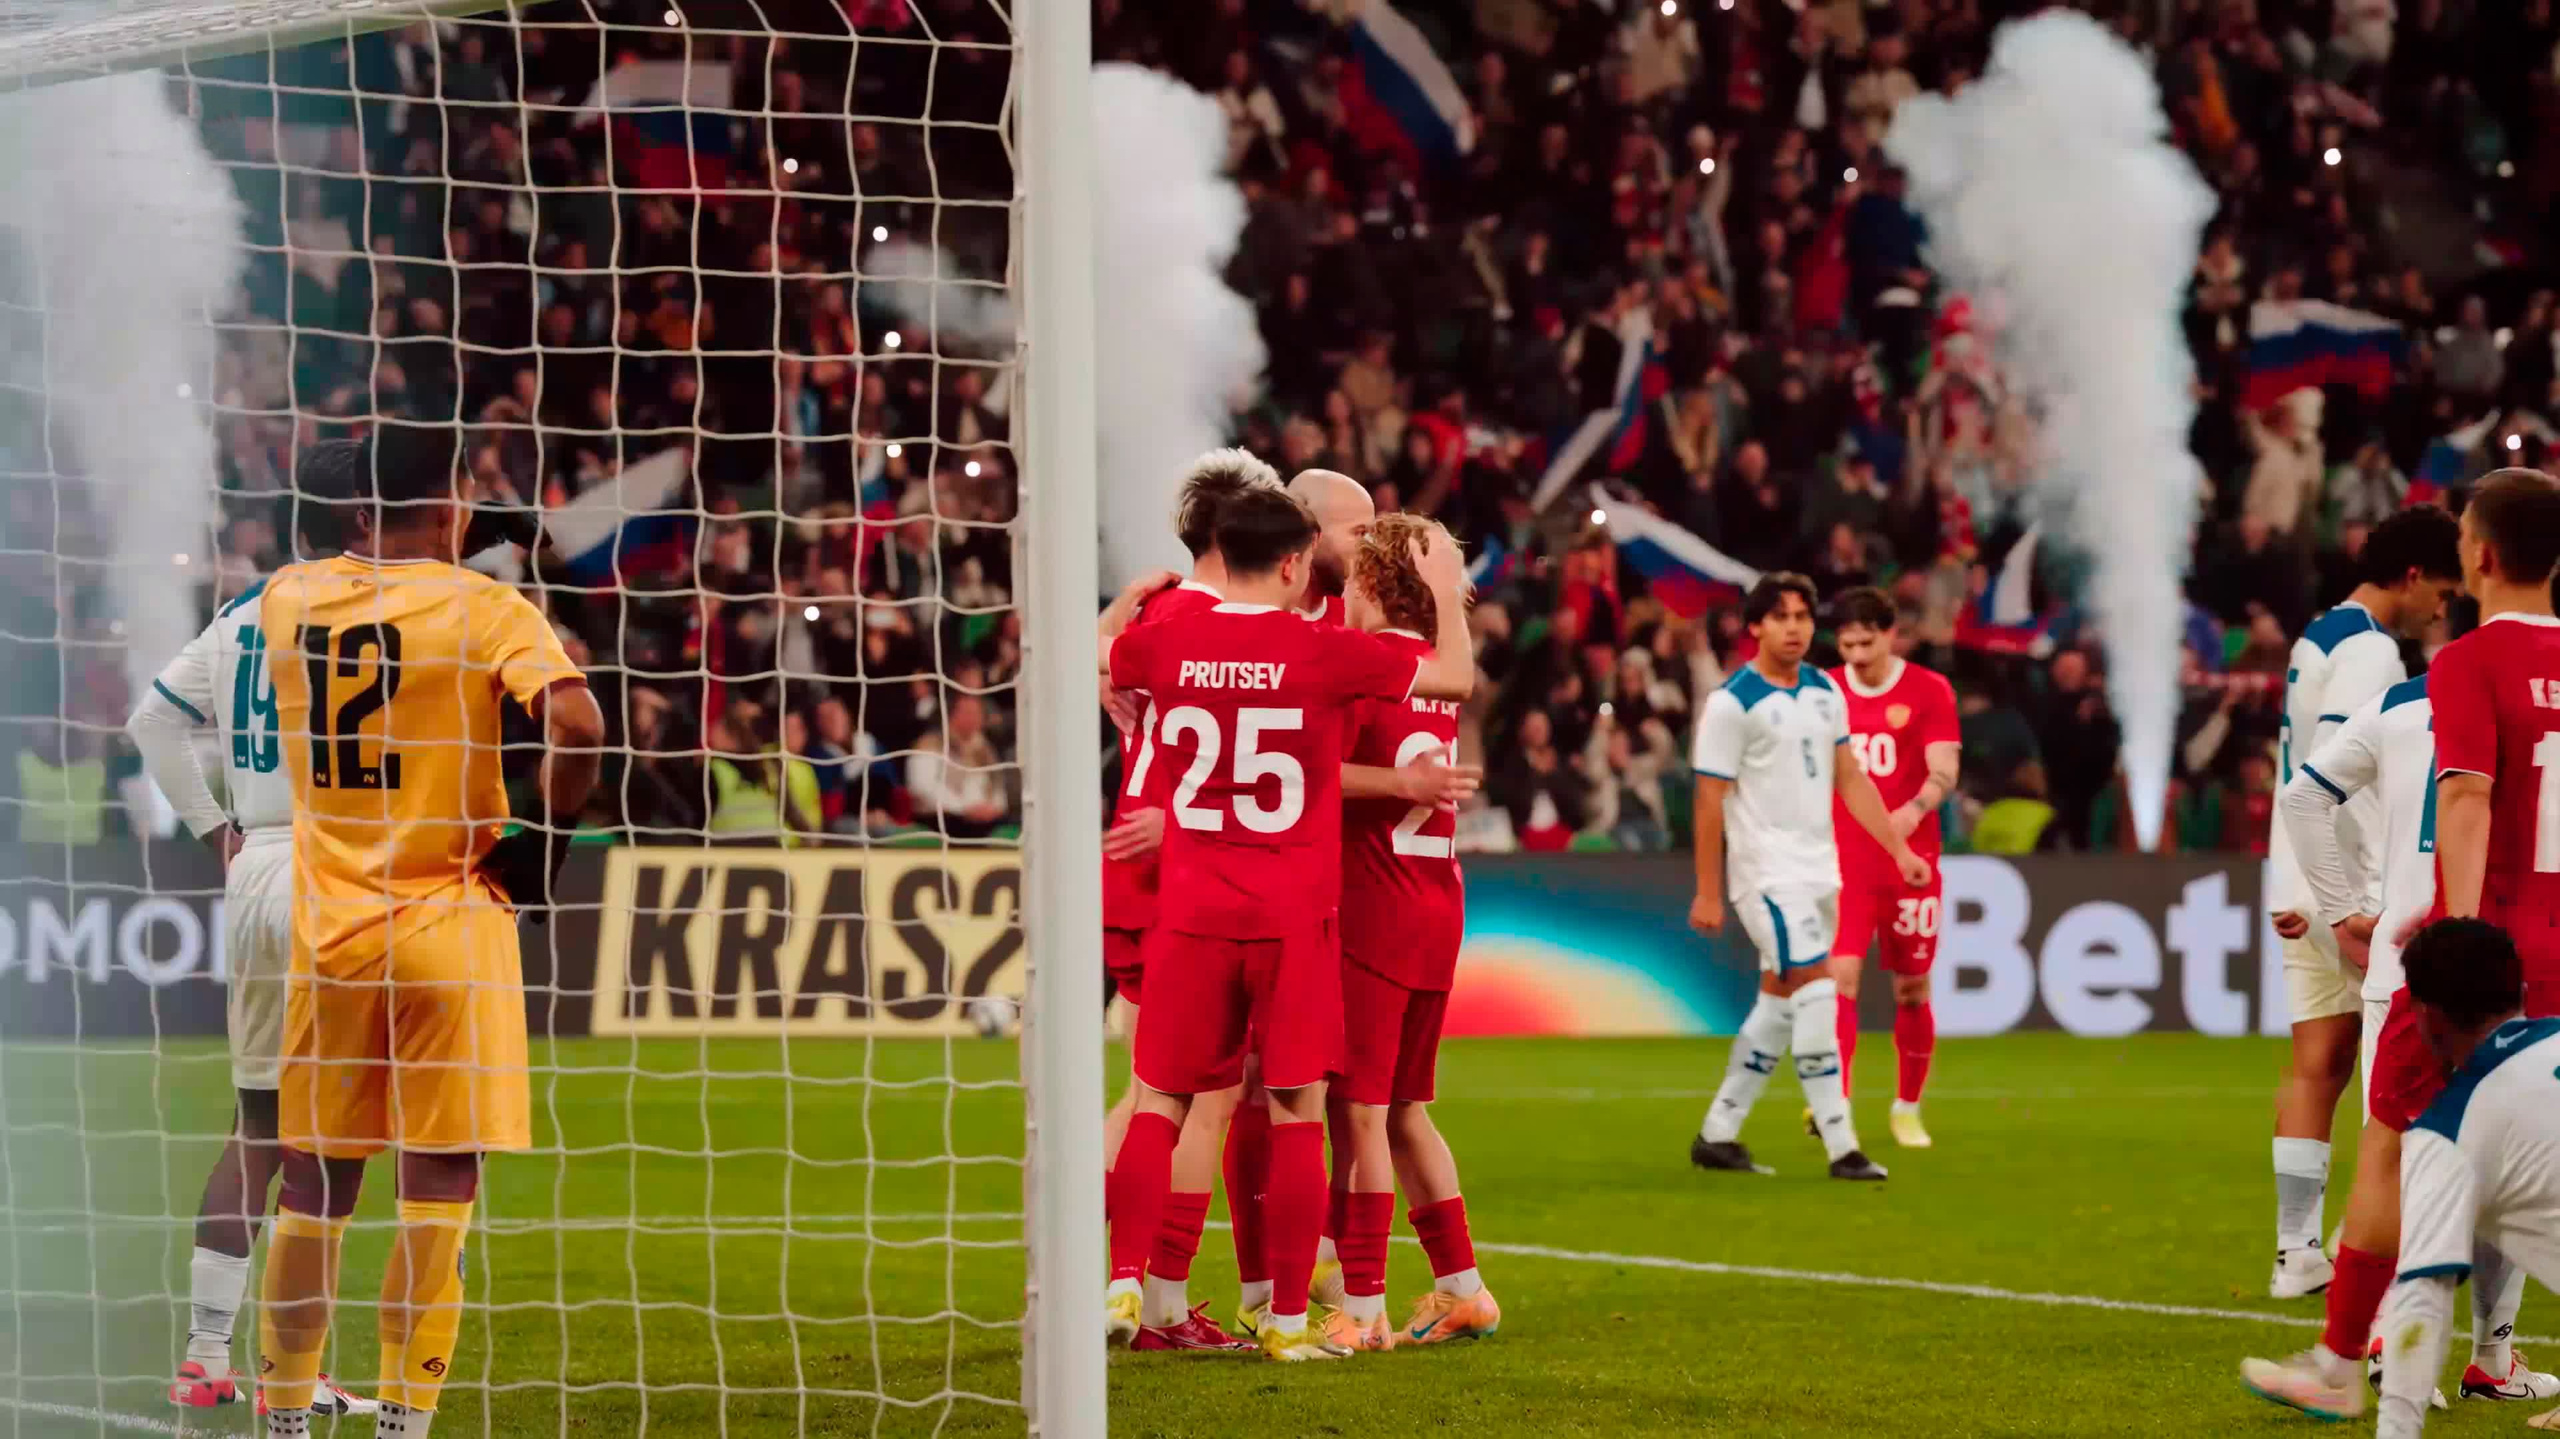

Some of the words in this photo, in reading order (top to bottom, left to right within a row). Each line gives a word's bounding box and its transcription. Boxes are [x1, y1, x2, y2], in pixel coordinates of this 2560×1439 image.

[294, 623, 400, 789] 12
[1178, 660, 1286, 690] PRUTSEV
[1161, 705, 1305, 834] 25
[1391, 731, 1458, 859] 2
[1850, 732, 1898, 777] 30
[0, 897, 226, 986] MO
[1892, 896, 1940, 938] 30
